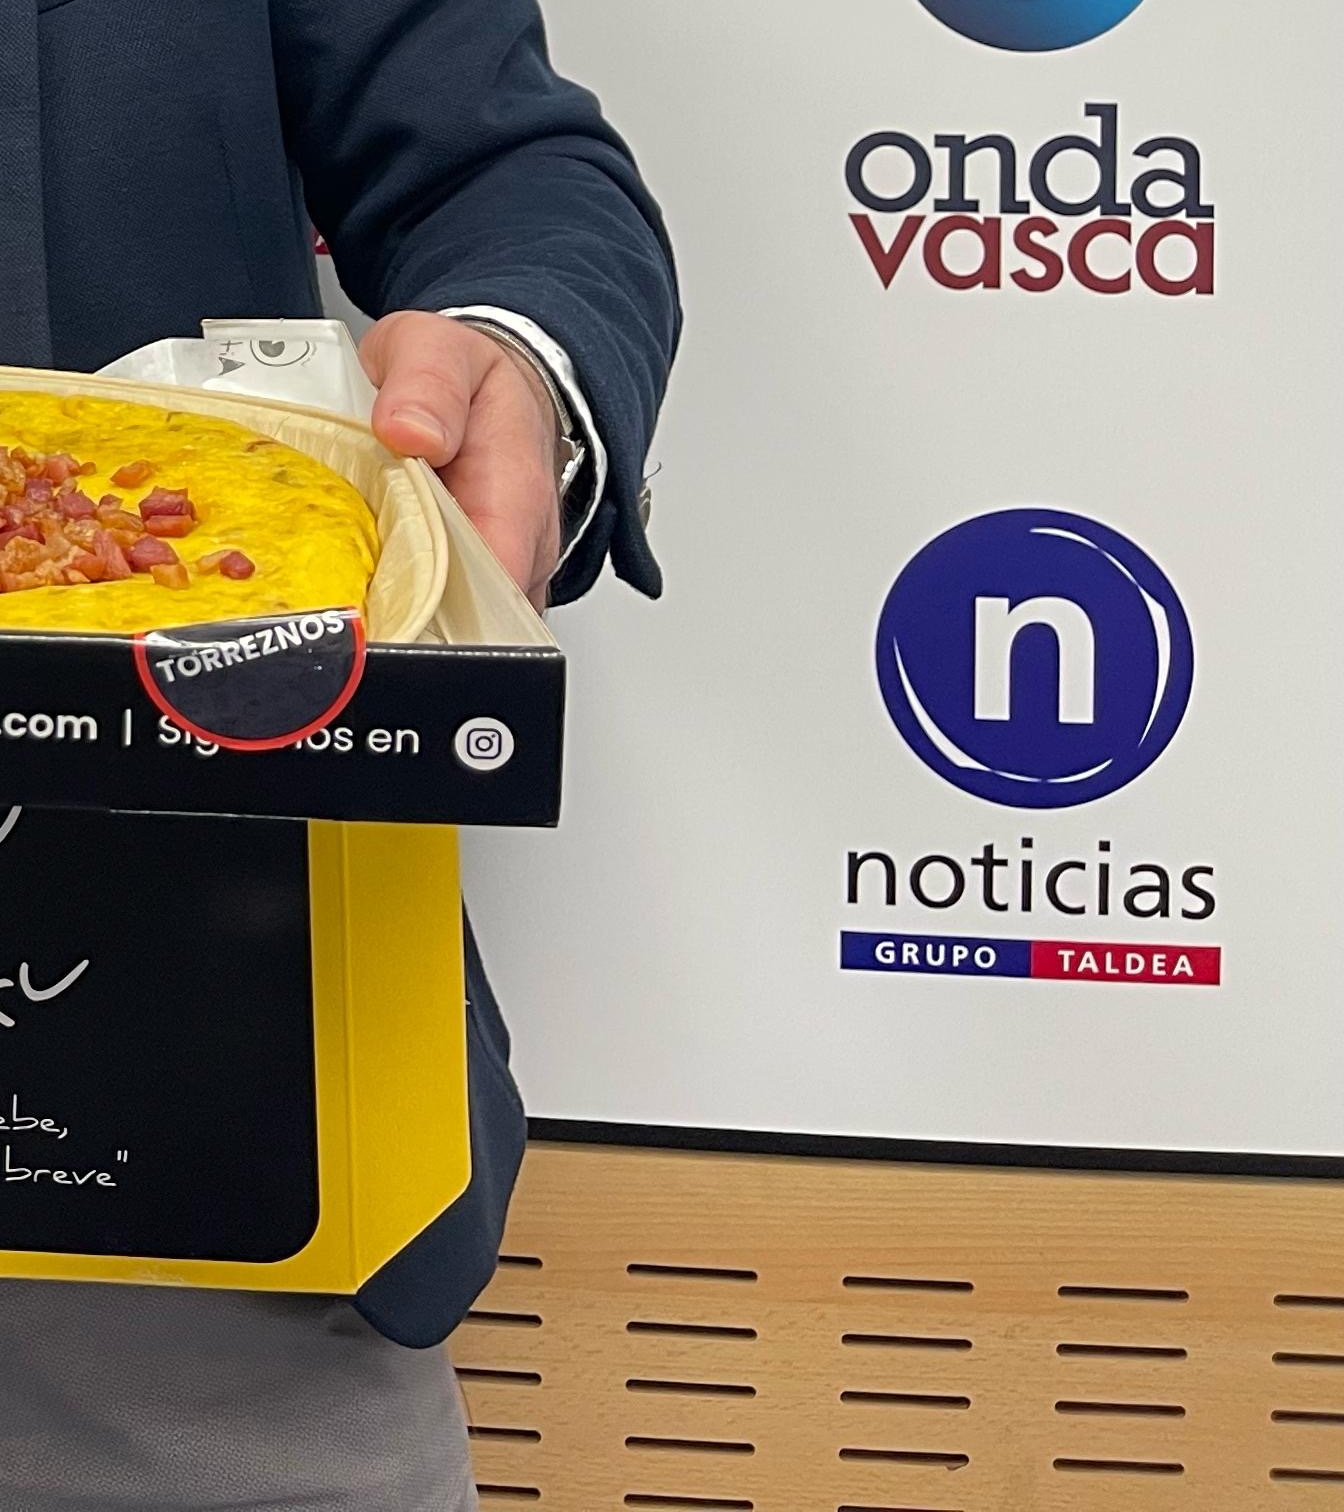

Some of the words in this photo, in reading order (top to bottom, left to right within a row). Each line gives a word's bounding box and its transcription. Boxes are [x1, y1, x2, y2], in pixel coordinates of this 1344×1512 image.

[845, 102, 1215, 219] onda
[847, 212, 1215, 296] vasca
[155, 610, 345, 683] TORREZNOS
[973, 594, 1096, 725] n
[367, 726, 420, 754] en
[846, 836, 1217, 921] noticias
[874, 940, 997, 969] GRUPO
[1057, 949, 1195, 978] TALDEA
[4, 1144, 129, 1187] breve"
